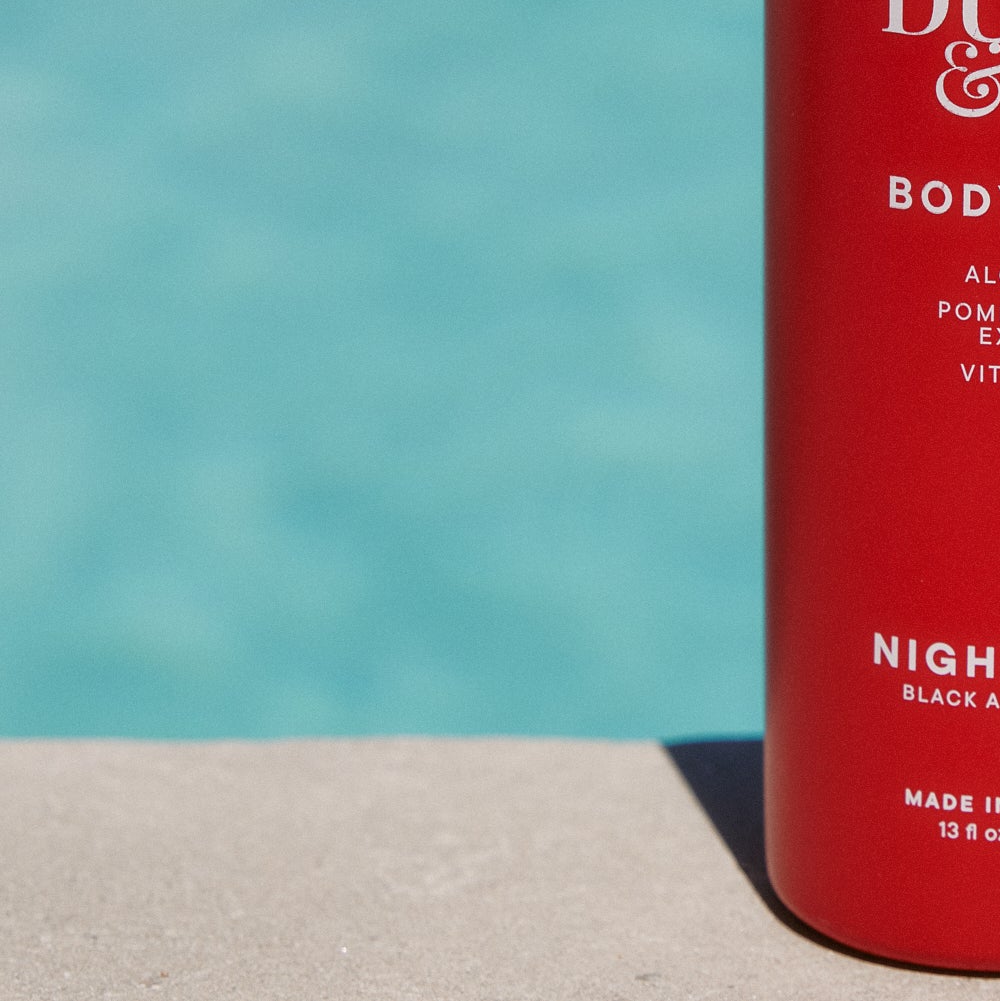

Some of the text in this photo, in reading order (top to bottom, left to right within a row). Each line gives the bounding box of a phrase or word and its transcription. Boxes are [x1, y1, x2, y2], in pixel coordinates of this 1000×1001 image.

[902, 683, 977, 709] BLACK
[904, 787, 974, 813] MADE
[938, 820, 960, 840] 13
[965, 822, 979, 841] fl
